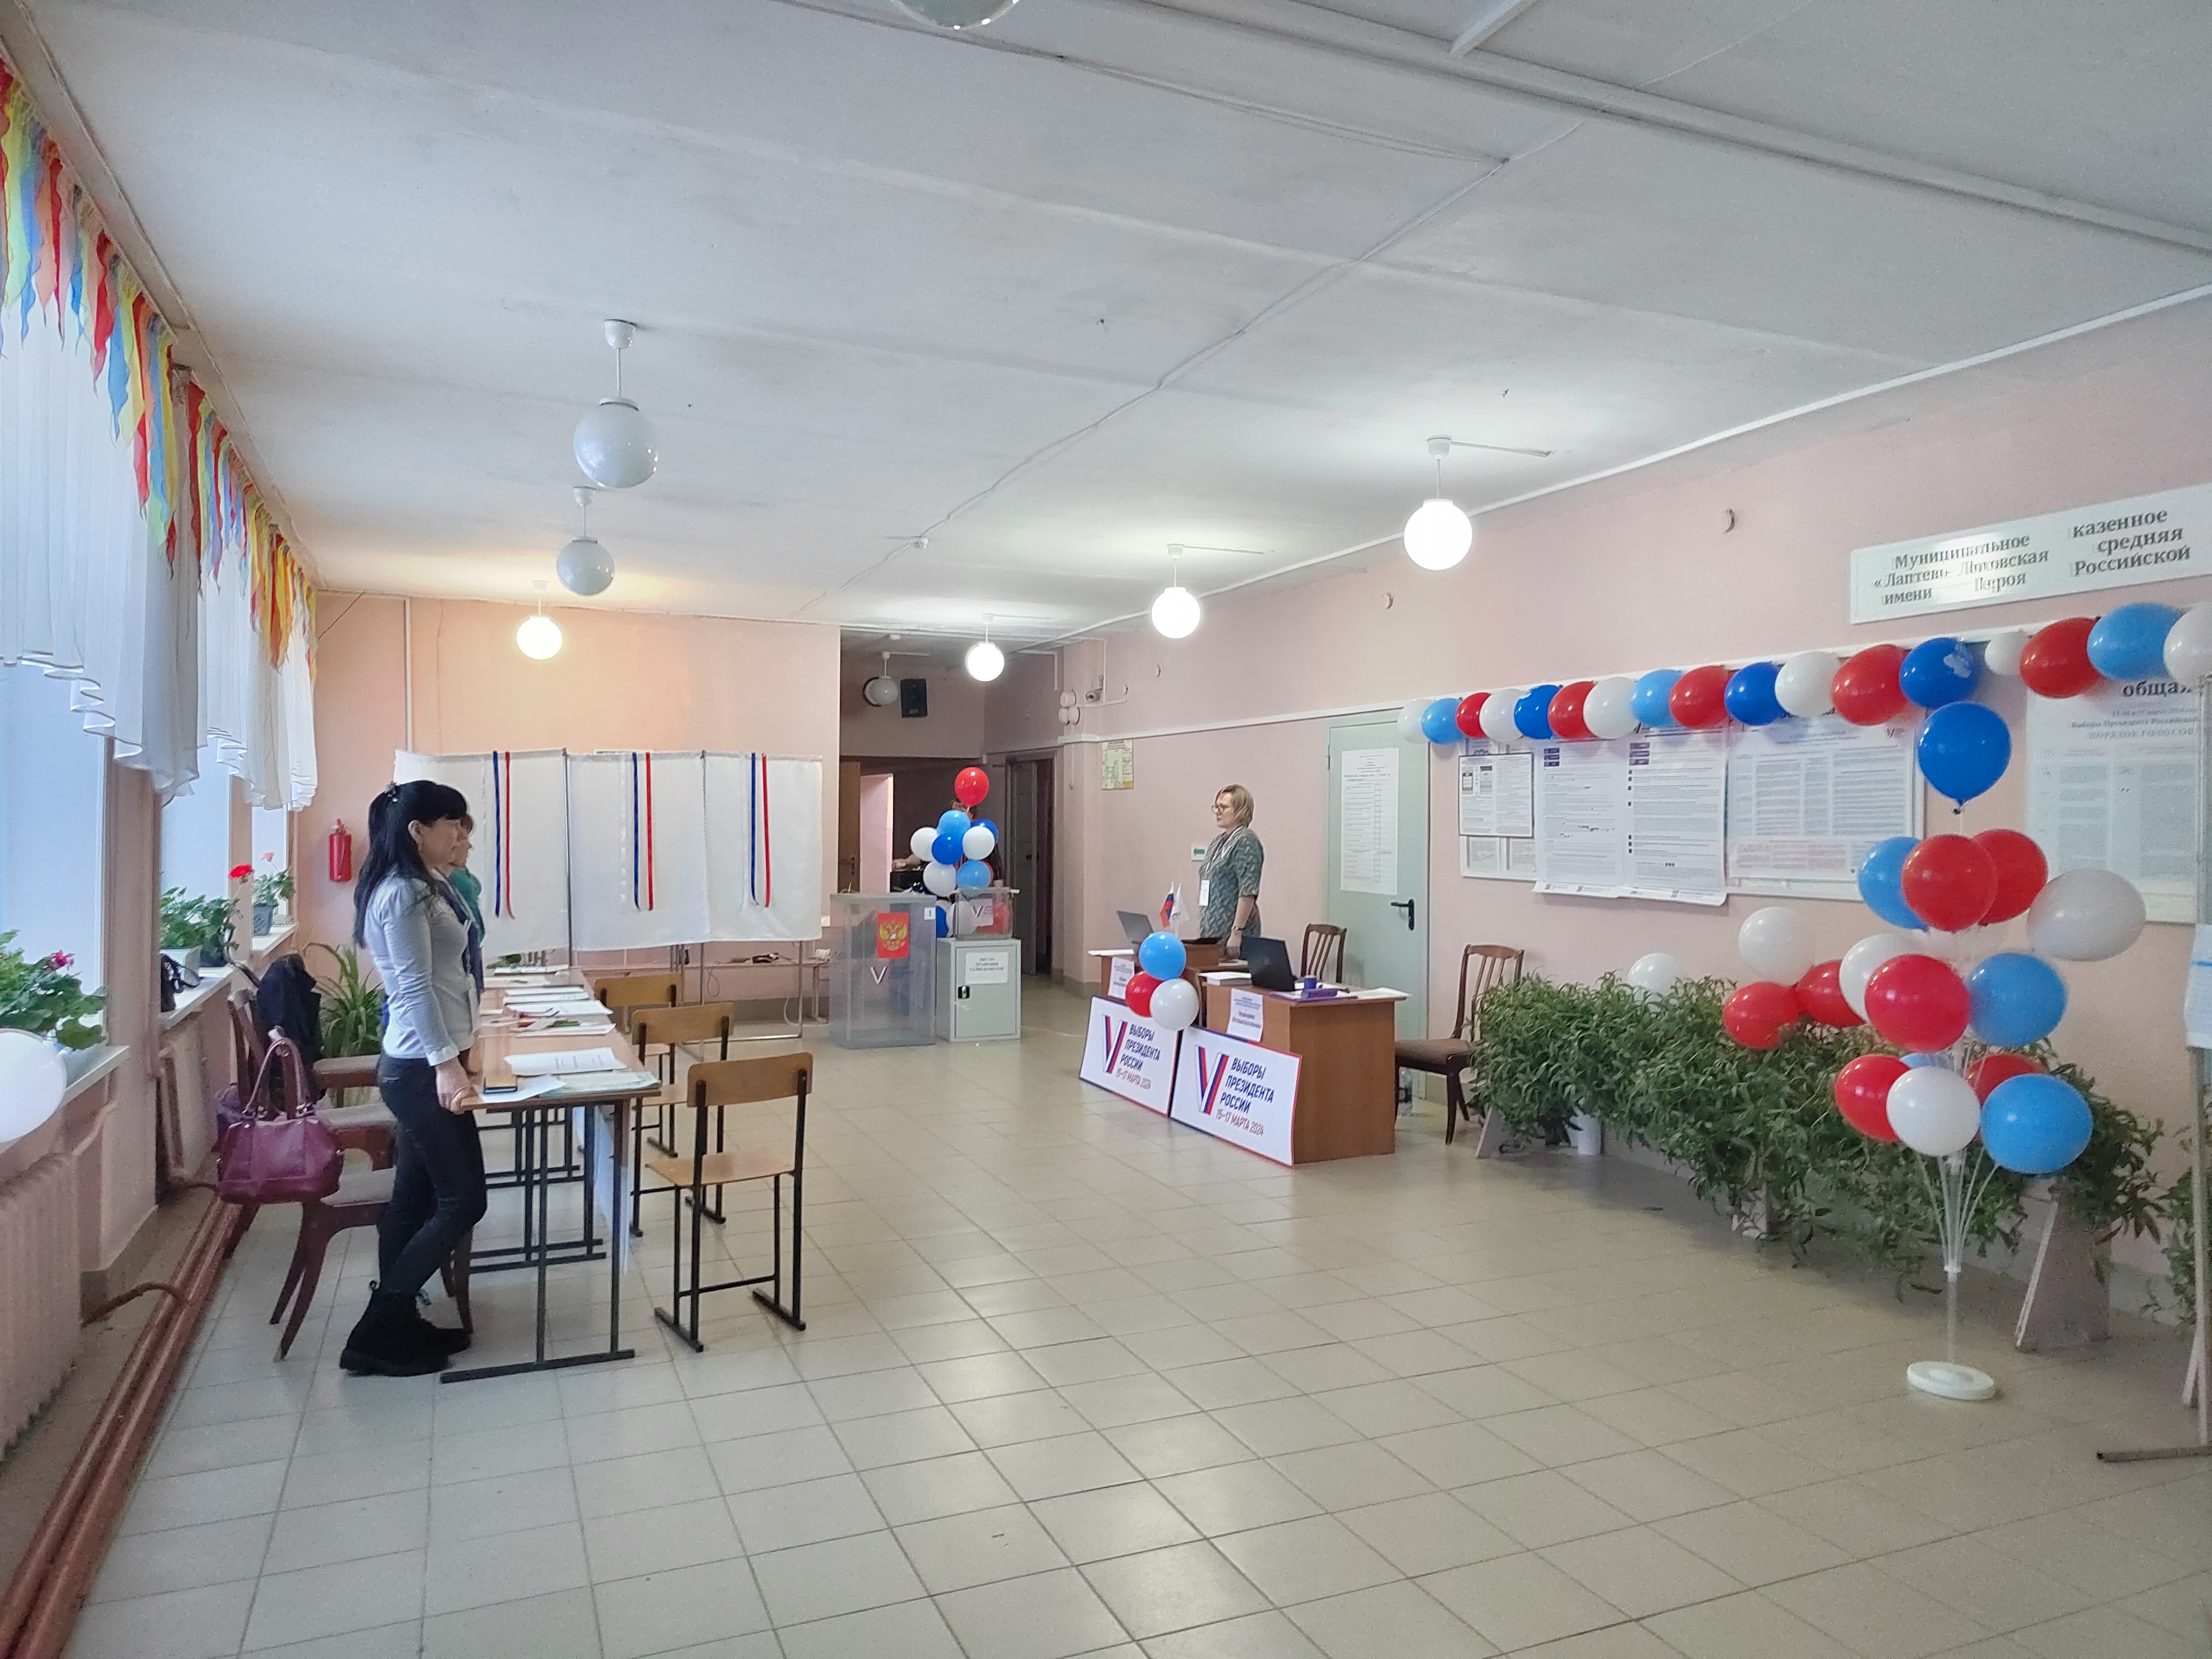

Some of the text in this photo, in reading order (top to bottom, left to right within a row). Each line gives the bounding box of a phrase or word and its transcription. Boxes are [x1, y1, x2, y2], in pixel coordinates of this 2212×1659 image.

[2072, 509, 2168, 538] казенное
[2098, 527, 2183, 556] средняя
[1885, 586, 1932, 605] имени
[2074, 544, 2191, 577] Российской
[1129, 1024, 1155, 1042] ВЫБОРЫ
[1125, 1039, 1161, 1061] ПРЕЗИДЕНТА
[1120, 1053, 1144, 1071] РОССИИ
[1231, 1057, 1267, 1079] ВЫБОРЫ
[1126, 1073, 1141, 1086] МАРТА
[1224, 1075, 1275, 1103] ПРЕЗИДЕНТА
[1219, 1092, 1252, 1114] РОССИИ
[1230, 1115, 1250, 1131] МАРТА
[1248, 1121, 1264, 1136] 2024
